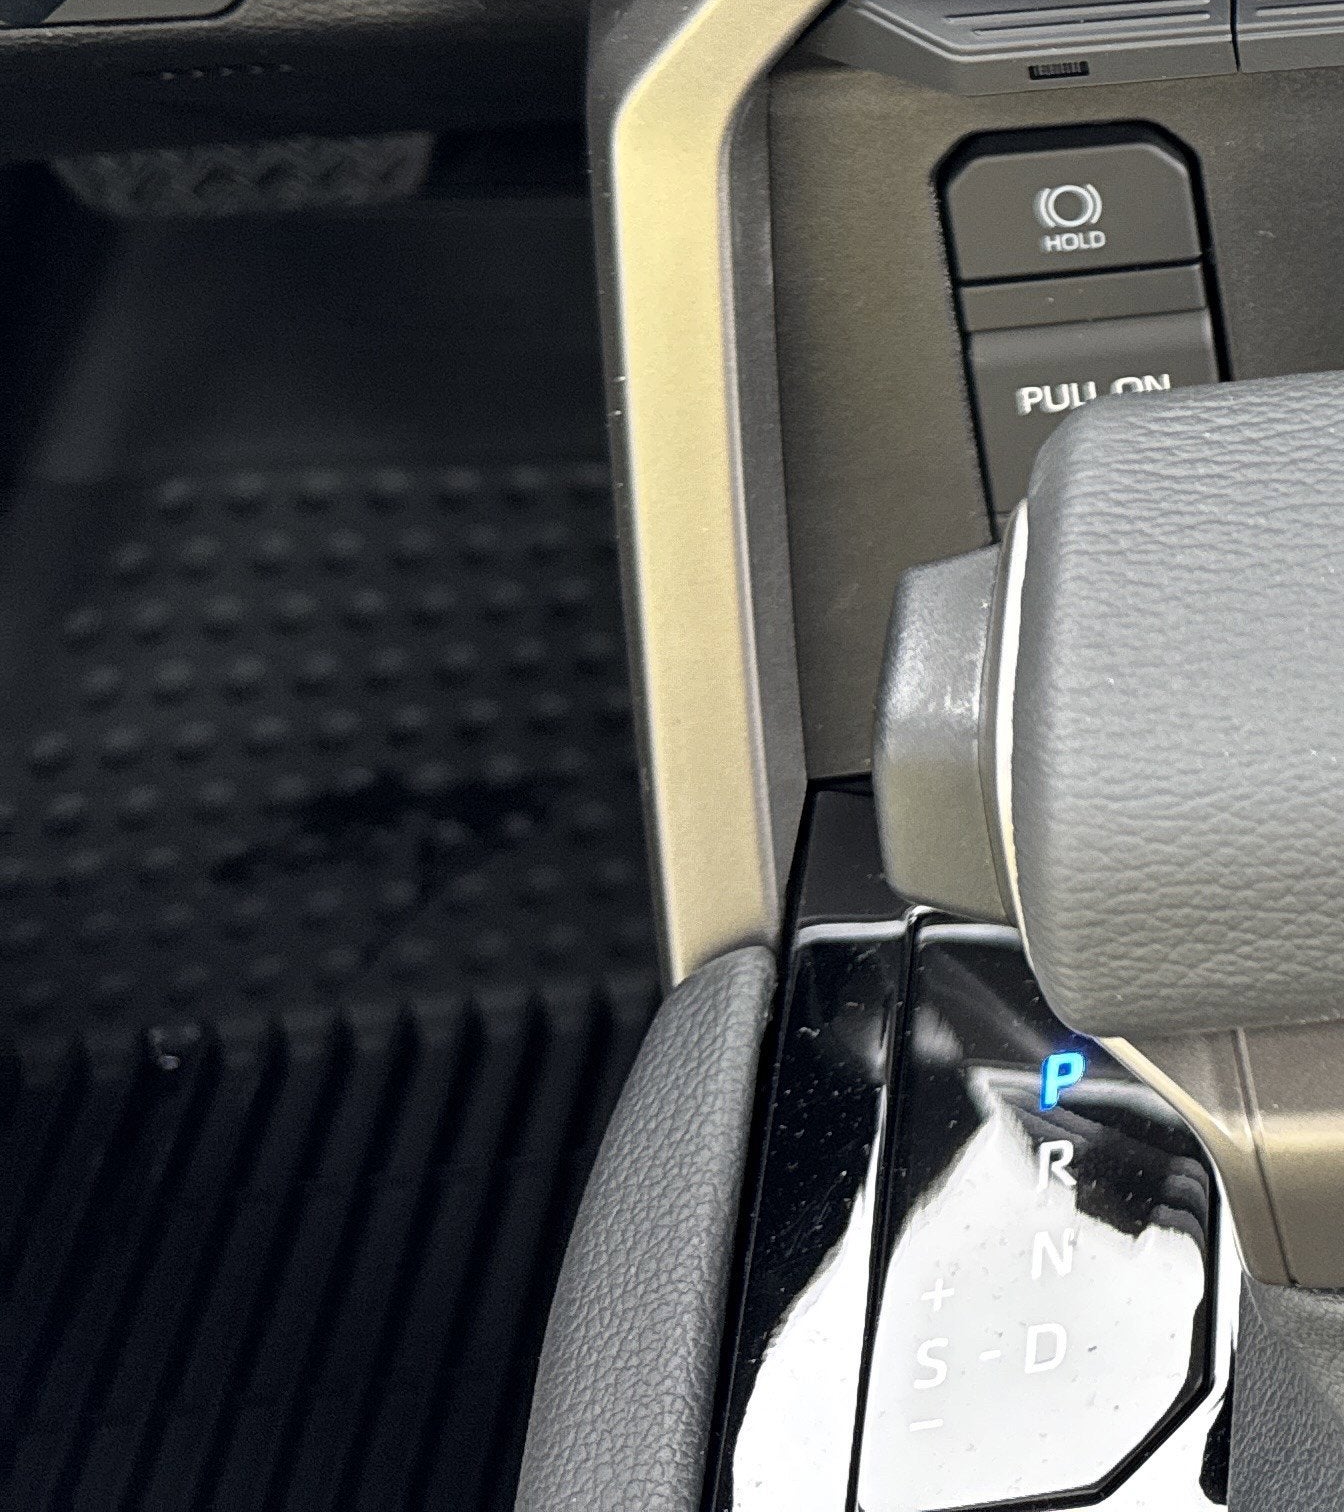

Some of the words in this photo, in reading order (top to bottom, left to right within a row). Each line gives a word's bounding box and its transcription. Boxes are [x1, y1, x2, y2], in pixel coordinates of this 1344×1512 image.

[1043, 230, 1106, 252] HOLD
[1016, 381, 1097, 416] PULL
[1041, 1051, 1086, 1111] P
[1037, 1140, 1077, 1190] R
[1031, 1228, 1075, 1280] N
[913, 1337, 949, 1389] S
[1024, 1322, 1067, 1374] D
